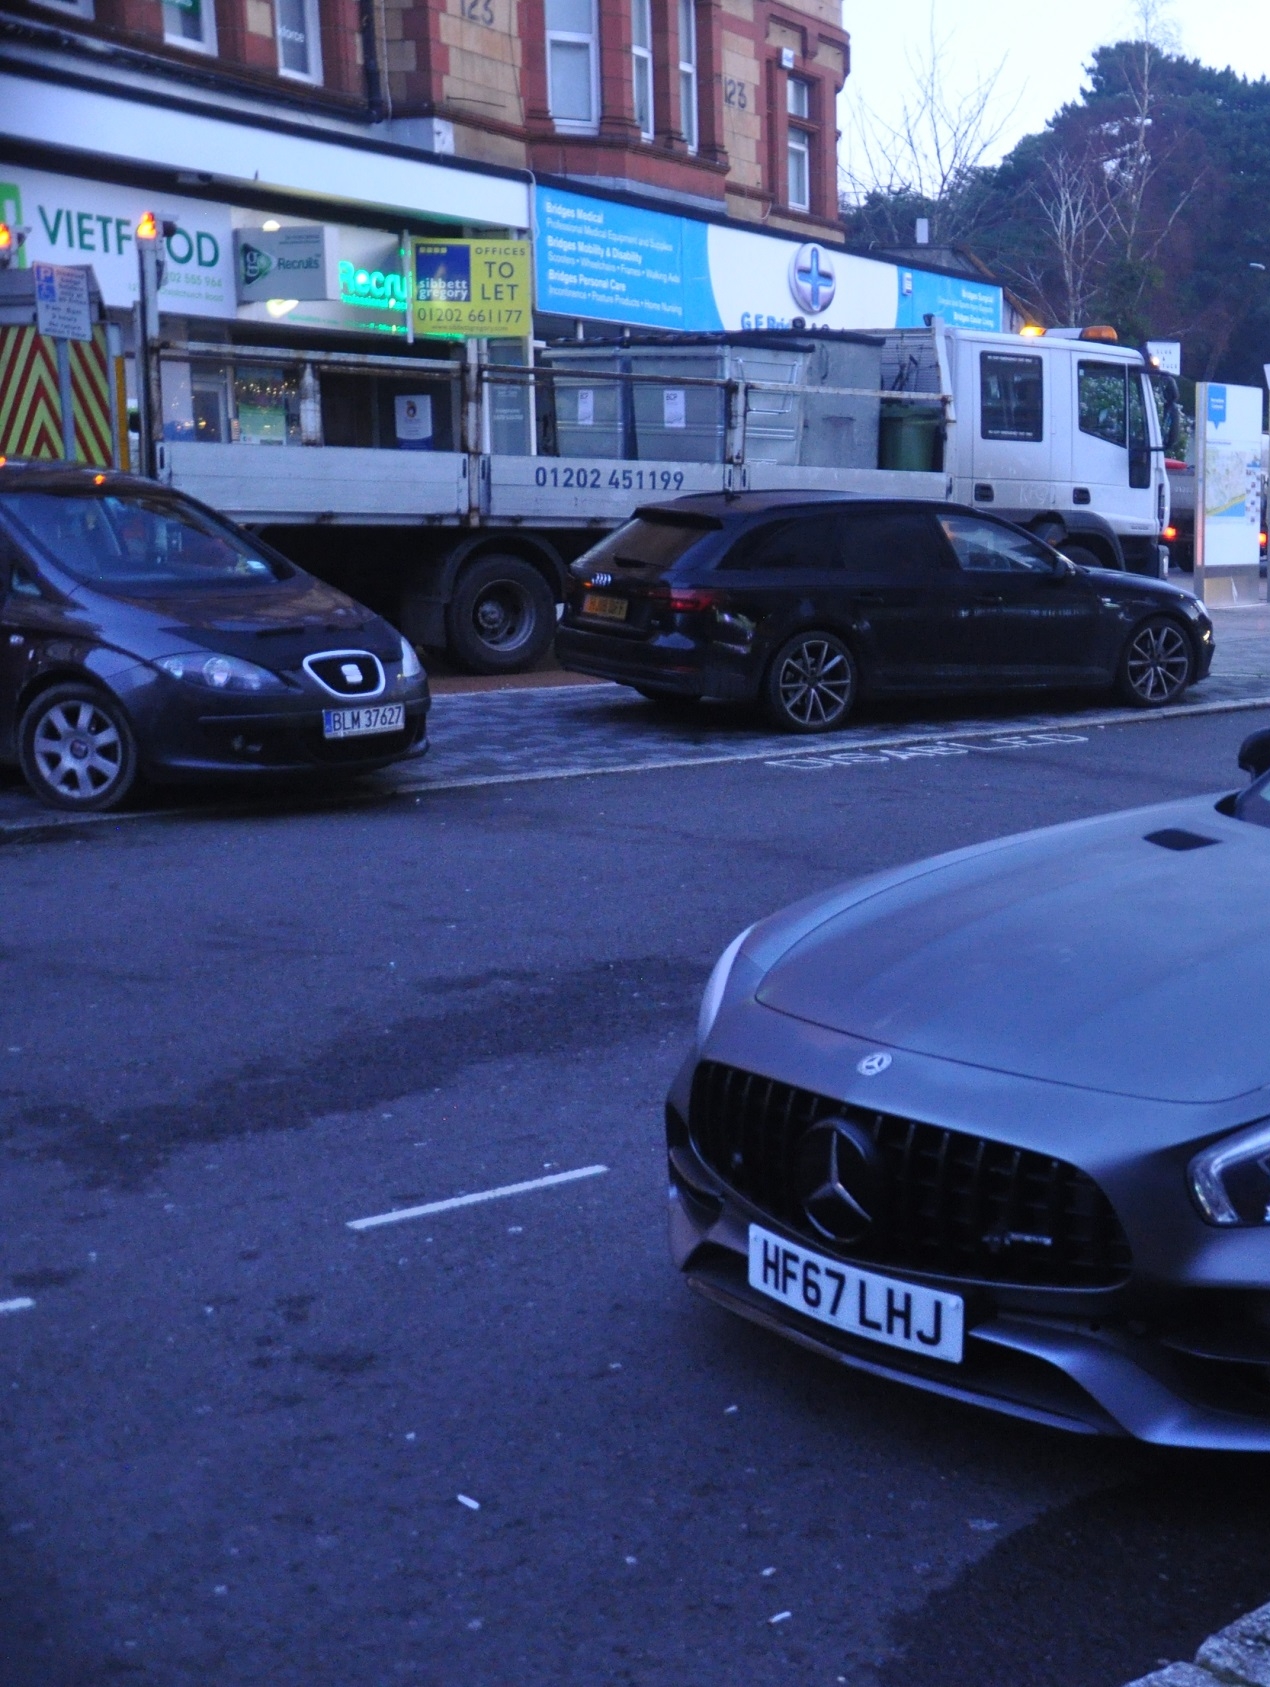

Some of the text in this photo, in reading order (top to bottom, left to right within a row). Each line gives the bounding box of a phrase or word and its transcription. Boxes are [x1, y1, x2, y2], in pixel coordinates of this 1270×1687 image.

[460, 0, 494, 26] 123
[723, 76, 747, 109] 123
[38, 205, 220, 267] VIETFOD
[475, 247, 526, 256] OFFICES
[277, 257, 320, 270] Recruits
[484, 261, 515, 279] TO
[419, 278, 468, 289] sibbett
[481, 283, 519, 301] LET
[419, 288, 468, 301] gregory
[418, 307, 522, 324] 01202 661177
[535, 466, 684, 490] 01202 451199
[333, 705, 402, 731] BLM 37627
[764, 734, 1089, 769] DISABLED
[762, 1238, 942, 1346] HF67 LHJ
